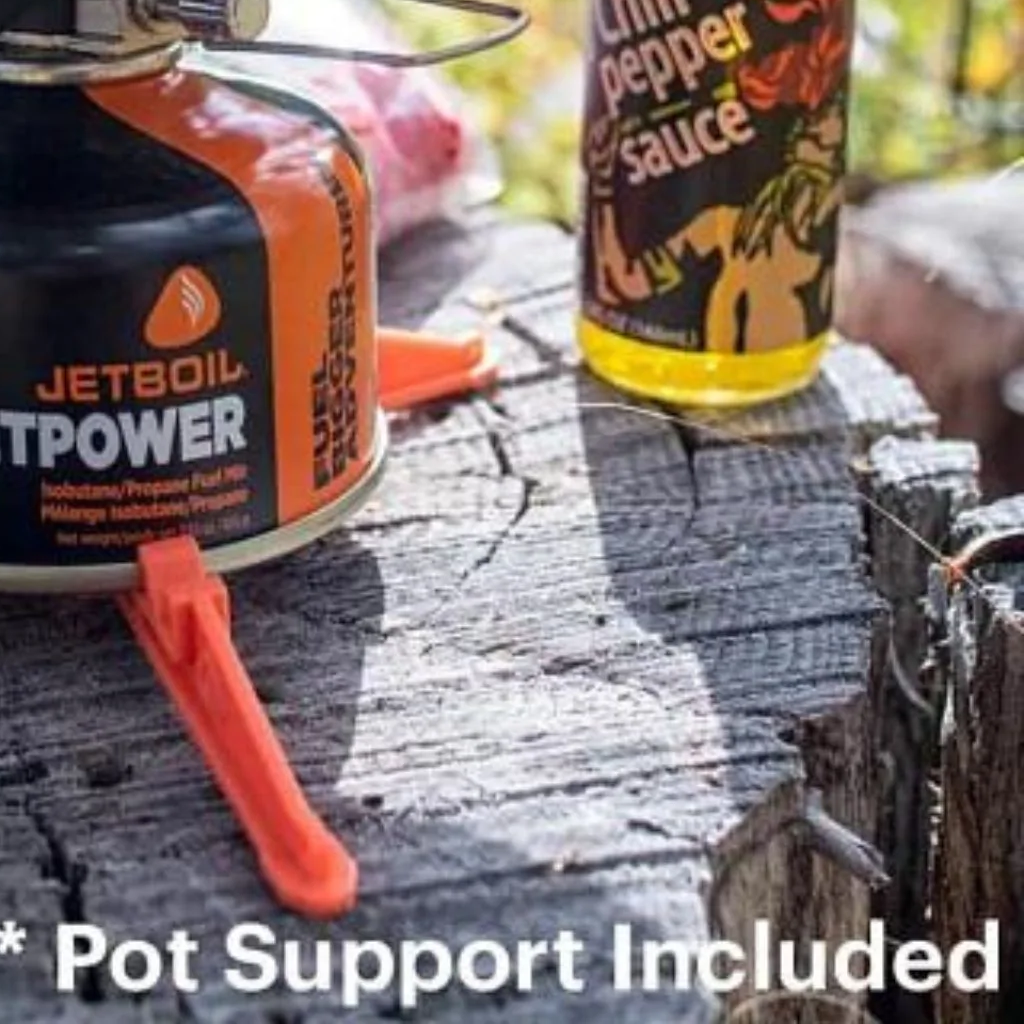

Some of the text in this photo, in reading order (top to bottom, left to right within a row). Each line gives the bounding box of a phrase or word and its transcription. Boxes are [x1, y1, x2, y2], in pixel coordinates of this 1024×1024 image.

[600, 2, 753, 118] pepper
[620, 98, 756, 184] sauce
[36, 349, 243, 402] JETBOIL
[311, 348, 330, 491] FUEL
